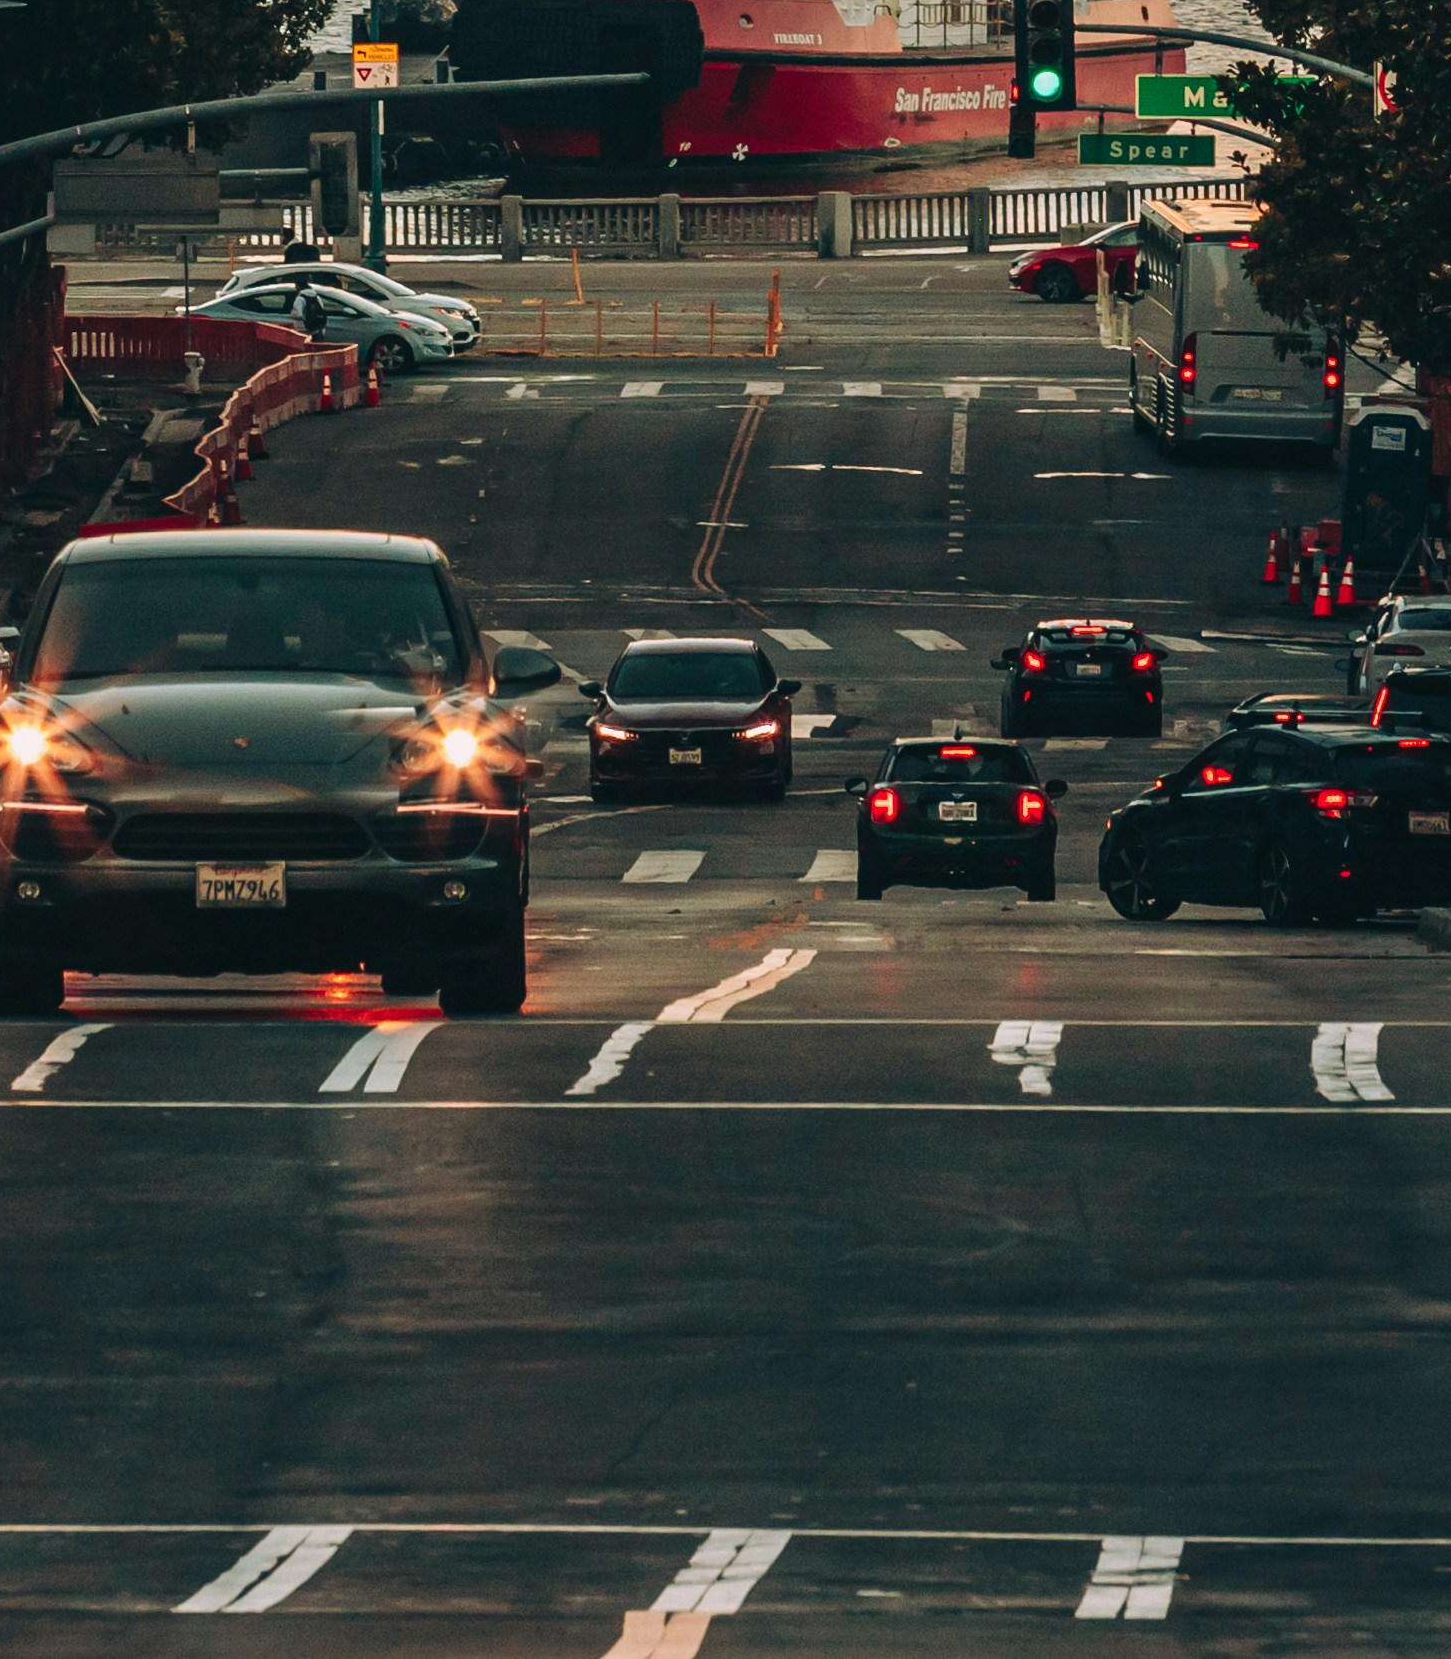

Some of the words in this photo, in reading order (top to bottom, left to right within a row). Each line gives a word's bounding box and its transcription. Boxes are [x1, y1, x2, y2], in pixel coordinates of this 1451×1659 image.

[894, 87, 919, 112] San
[921, 85, 981, 112] Francisco
[982, 84, 1006, 109] Fire
[1183, 85, 1228, 109] Ma
[1110, 140, 1189, 161] Spear
[201, 879, 280, 901] 7PMZ946
